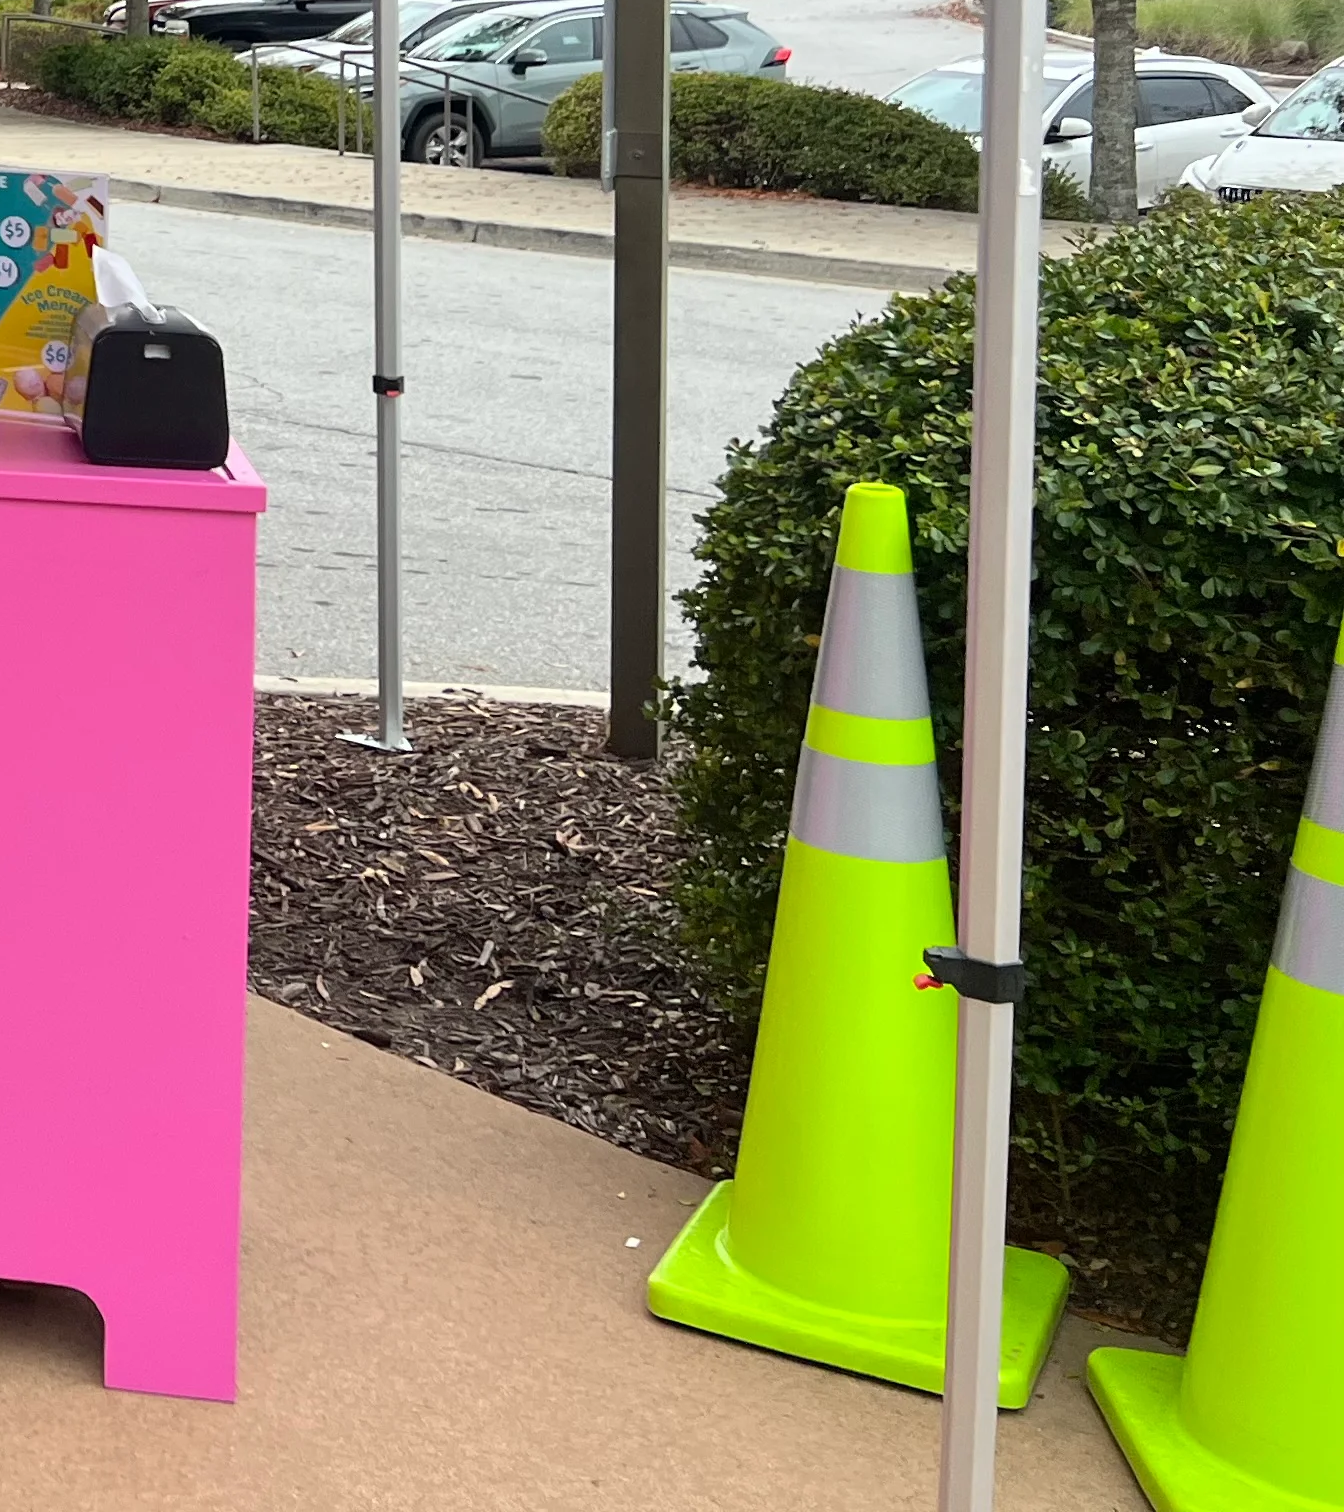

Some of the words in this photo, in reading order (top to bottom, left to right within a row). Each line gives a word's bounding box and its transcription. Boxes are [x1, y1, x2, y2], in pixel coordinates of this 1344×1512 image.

[5, 219, 24, 240] $5
[21, 289, 44, 304] Ice
[37, 300, 79, 315] Menu
[46, 344, 66, 365] $6
